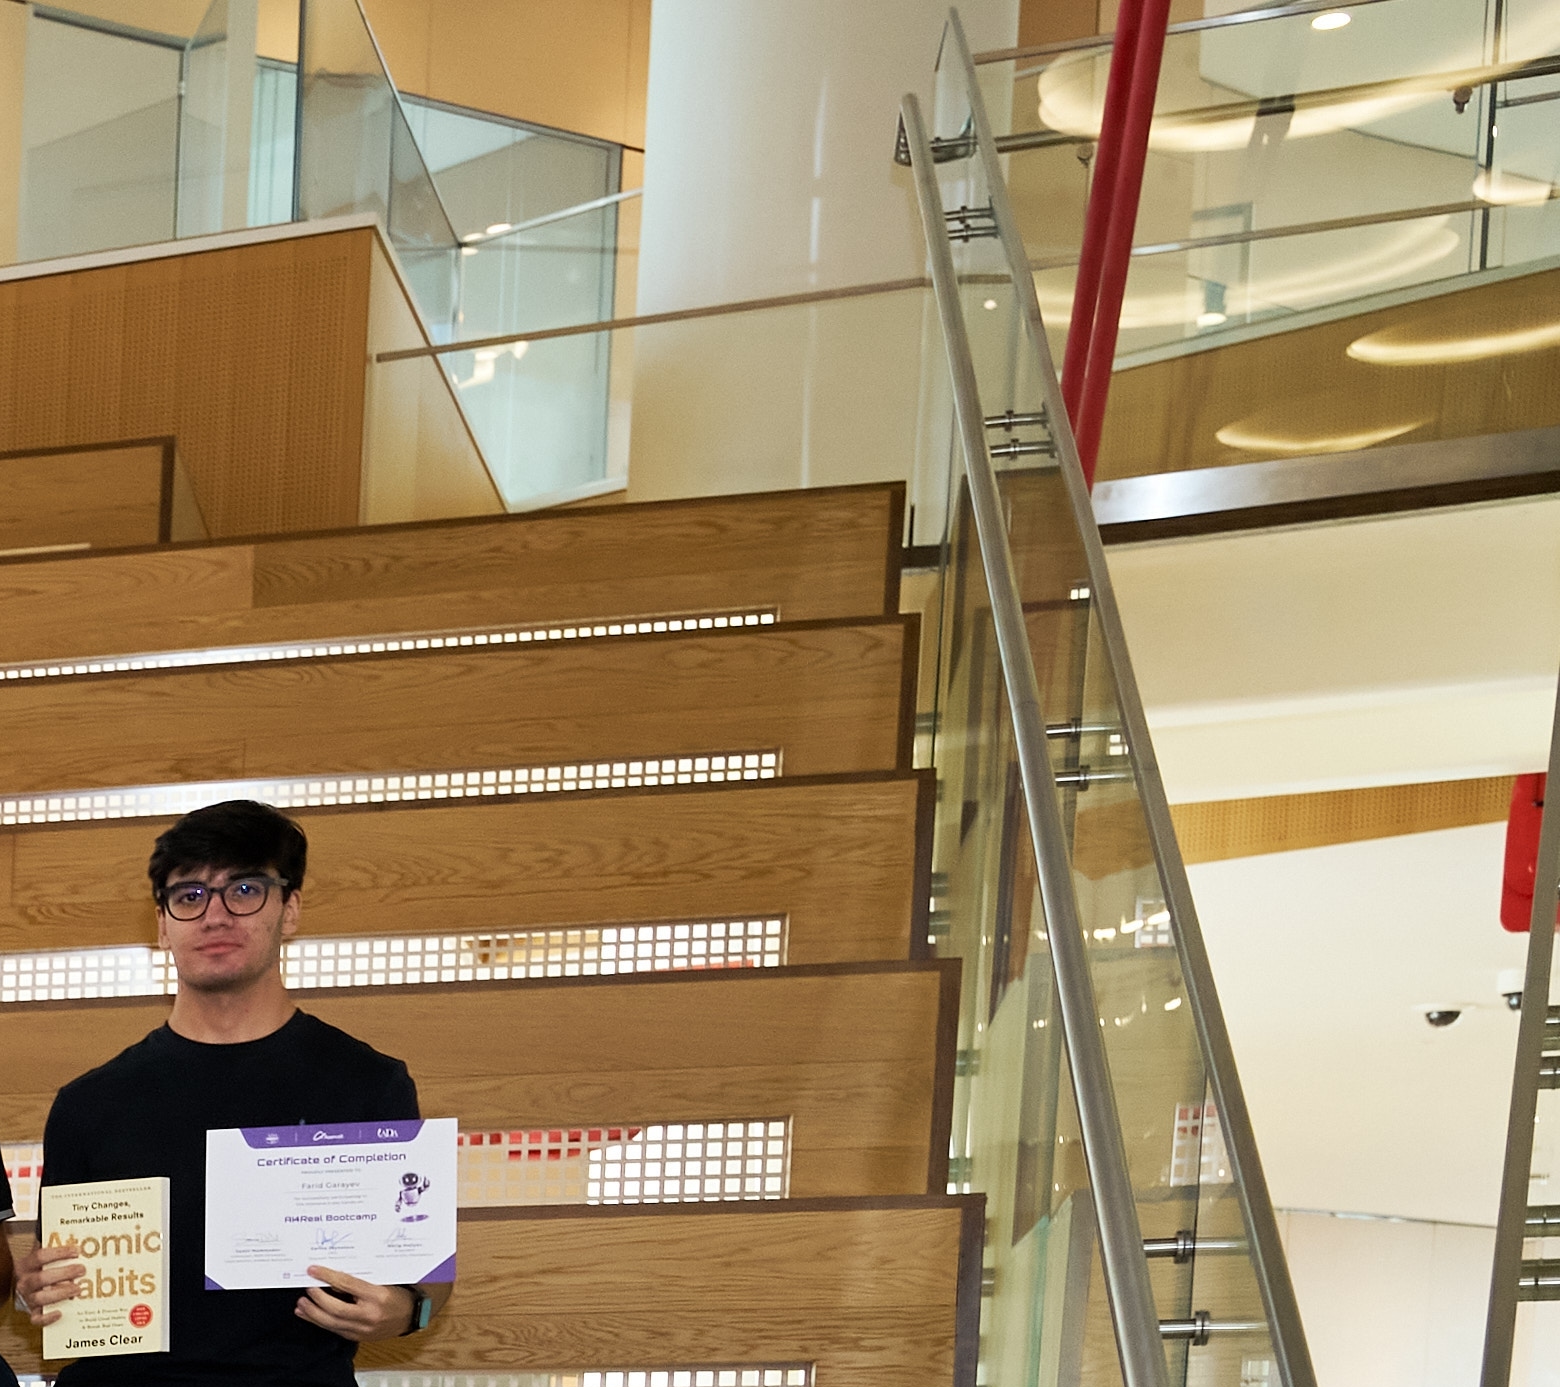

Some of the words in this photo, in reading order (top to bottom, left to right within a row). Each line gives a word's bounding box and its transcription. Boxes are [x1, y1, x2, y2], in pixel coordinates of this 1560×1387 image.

[257, 1155, 319, 1167] Certificate
[324, 1154, 336, 1164] of
[339, 1151, 406, 1164] Completion
[91, 1200, 130, 1210] Changes,
[60, 1216, 108, 1225] Remarkable
[111, 1212, 144, 1220] Results
[326, 1212, 377, 1224] Bootcamp
[78, 1268, 156, 1299] abits
[66, 1338, 105, 1349] James
[110, 1335, 143, 1345] Clear
